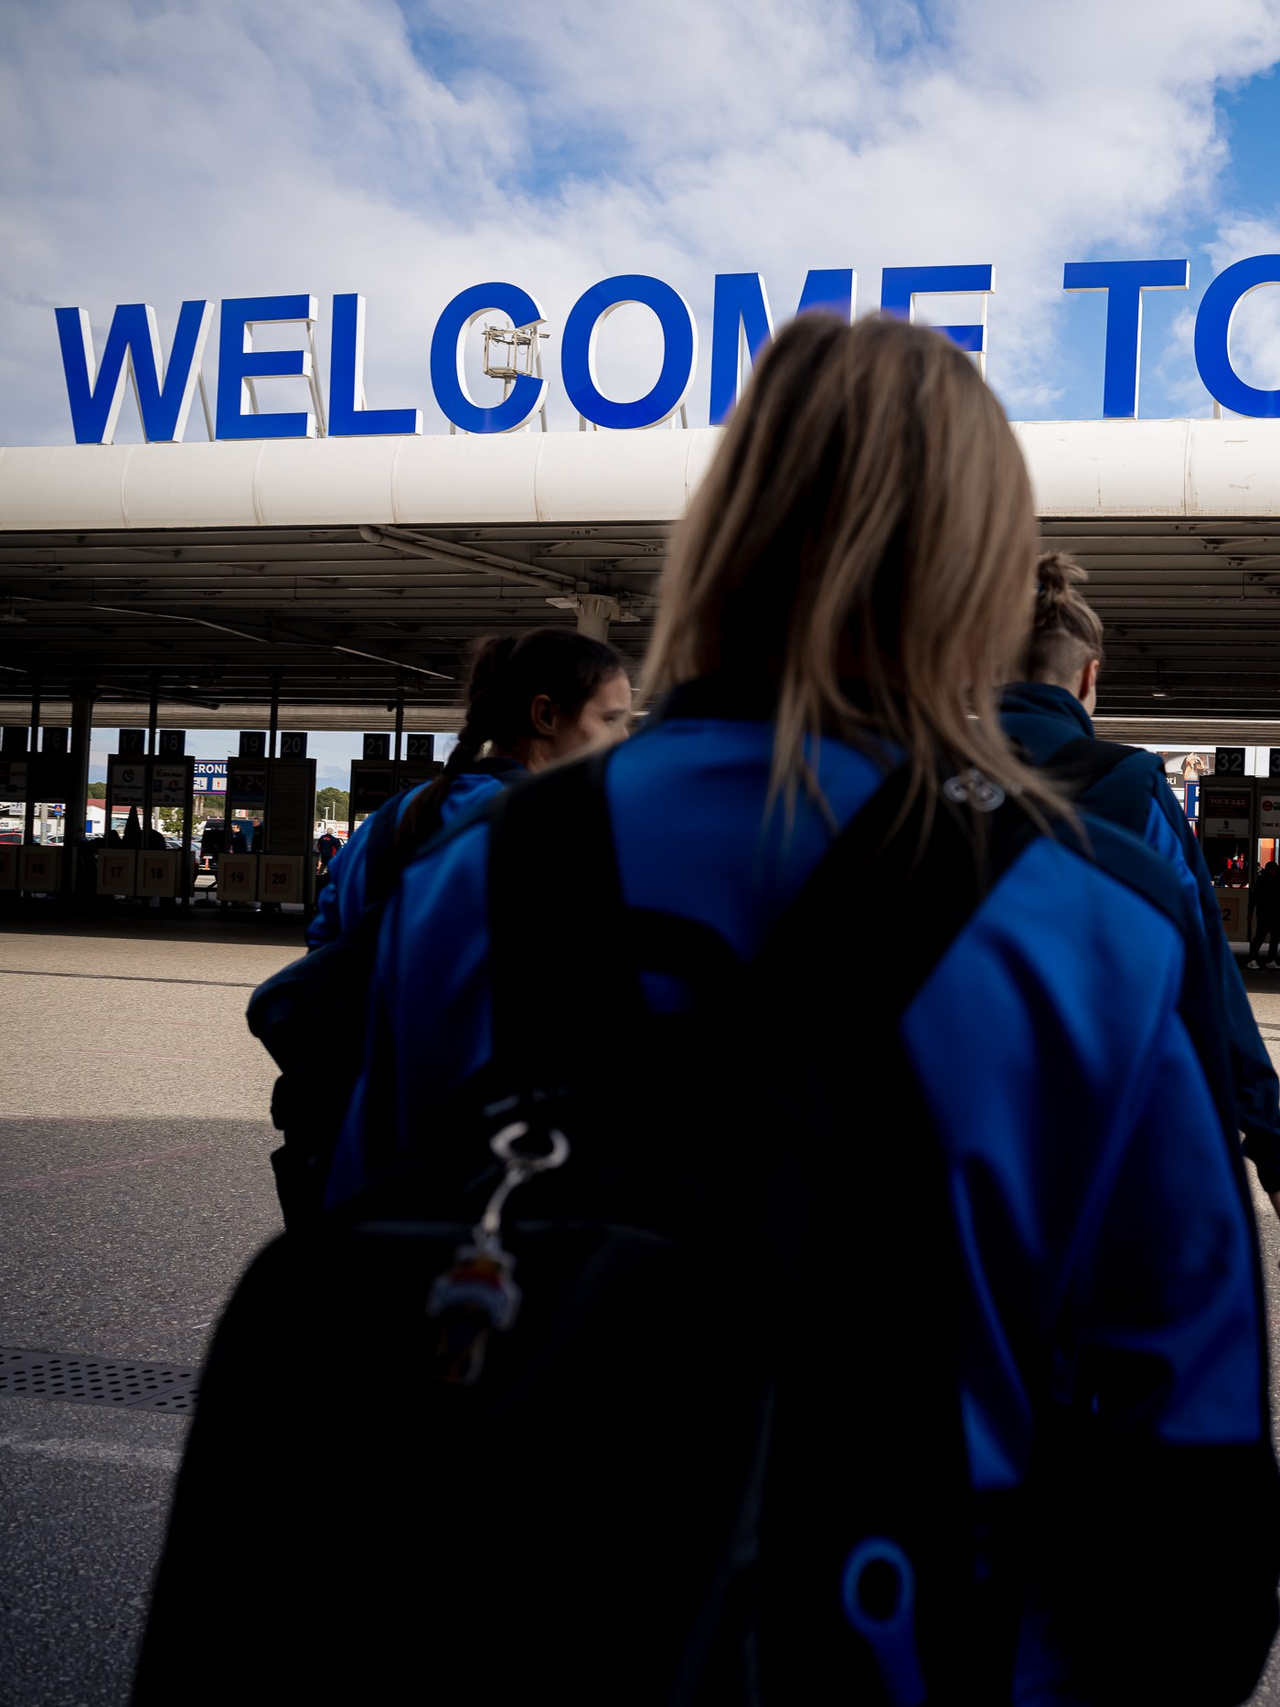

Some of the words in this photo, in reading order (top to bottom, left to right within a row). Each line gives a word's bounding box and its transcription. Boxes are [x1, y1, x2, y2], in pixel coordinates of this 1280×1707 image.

[121, 734, 139, 750] 17
[161, 734, 179, 751] 18
[242, 736, 259, 752] 19
[282, 736, 301, 753] 20
[365, 738, 383, 755] 21
[408, 739, 429, 756] 22
[1217, 752, 1242, 771] 32
[31, 863, 44, 874] 16
[110, 866, 123, 878] 17
[150, 868, 163, 879] 18
[231, 871, 244, 884] 19
[272, 873, 286, 885] 20
[1222, 908, 1231, 921] 2
